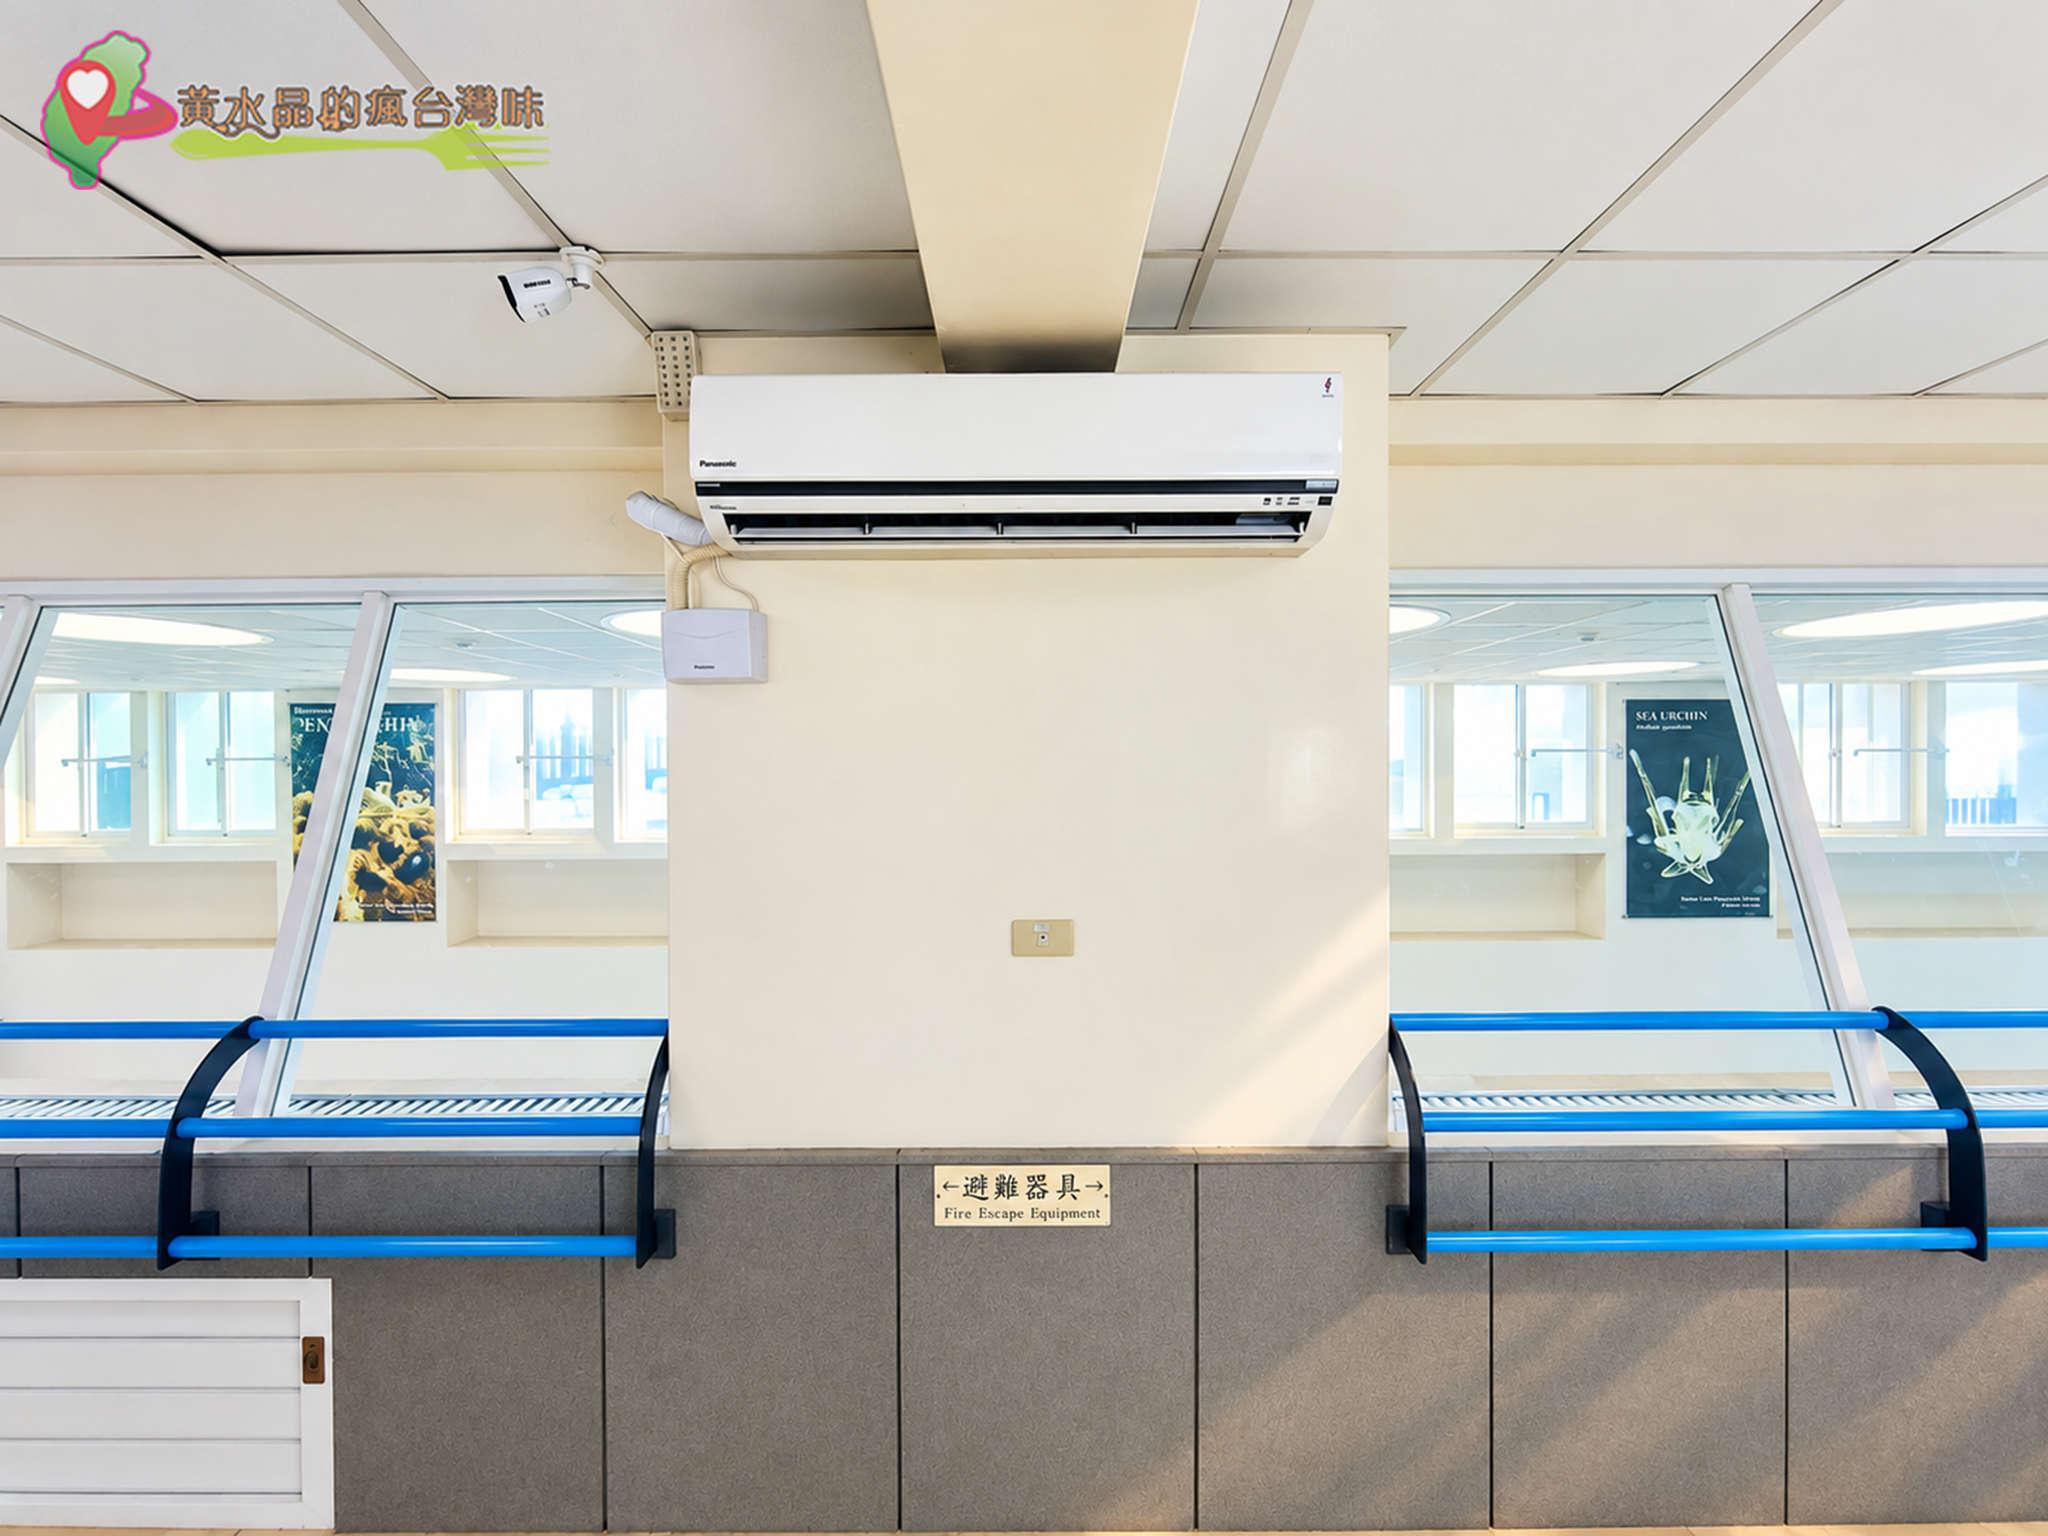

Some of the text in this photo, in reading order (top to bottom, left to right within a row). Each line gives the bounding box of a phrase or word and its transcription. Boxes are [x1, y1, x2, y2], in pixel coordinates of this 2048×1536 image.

[1636, 711, 1708, 721] SEA URCHIN
[962, 1173, 1080, 1201] 避難器具
[944, 1207, 1101, 1222] Fire Escape Equipment
